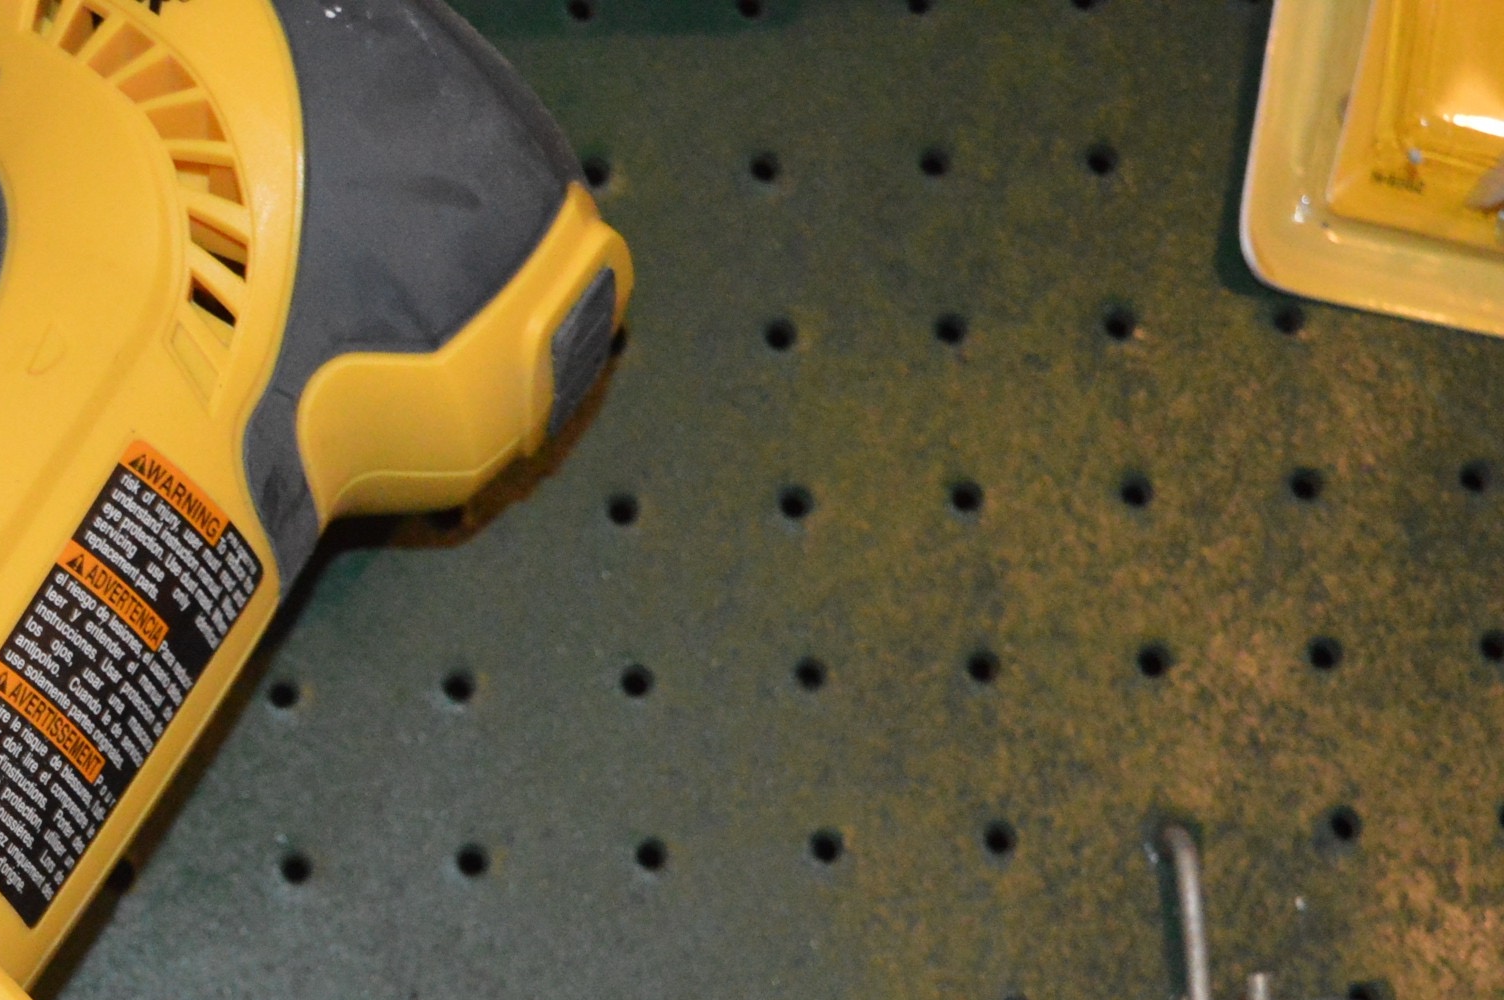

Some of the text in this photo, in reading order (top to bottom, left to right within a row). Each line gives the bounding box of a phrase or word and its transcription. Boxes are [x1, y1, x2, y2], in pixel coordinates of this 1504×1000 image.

[111, 488, 163, 534] understand
[160, 527, 200, 571] instruction
[120, 474, 141, 495] risk
[141, 491, 157, 505] of
[155, 500, 181, 532] injury,
[182, 528, 203, 551] user
[144, 460, 220, 539] WARNING
[84, 530, 159, 601] replacement parts.
[93, 516, 138, 559] servicing
[146, 562, 165, 582] use
[102, 502, 123, 522] eye
[119, 516, 164, 561] protection.
[164, 553, 182, 577] Use
[216, 536, 227, 555] To
[35, 600, 97, 662] instrucciones.
[100, 656, 123, 684] Usar
[45, 584, 68, 609] leer
[69, 608, 82, 623] y
[85, 620, 125, 660] entender
[126, 661, 140, 675] el
[55, 572, 154, 666] el riesgo de lesiones, el
[85, 565, 163, 646] ADVERTENCIA
[14, 634, 60, 677] antipolvo.
[68, 676, 102, 715] Cuando
[101, 709, 112, 726] le
[25, 615, 125, 715] los ojos, usar una
[157, 639, 176, 667] Para
[4, 649, 26, 670] use
[24, 664, 71, 710] solamente
[67, 704, 95, 735] partes
[9, 683, 103, 775] AVERTISSEMENT
[2, 736, 23, 758] doit
[22, 752, 39, 773] lire
[39, 771, 52, 786] et
[9, 715, 22, 733] le
[20, 727, 49, 757] risque
[49, 755, 63, 771] de
[0, 786, 43, 833] protection,
[52, 808, 75, 838] Porter
[39, 849, 56, 874] Lors
